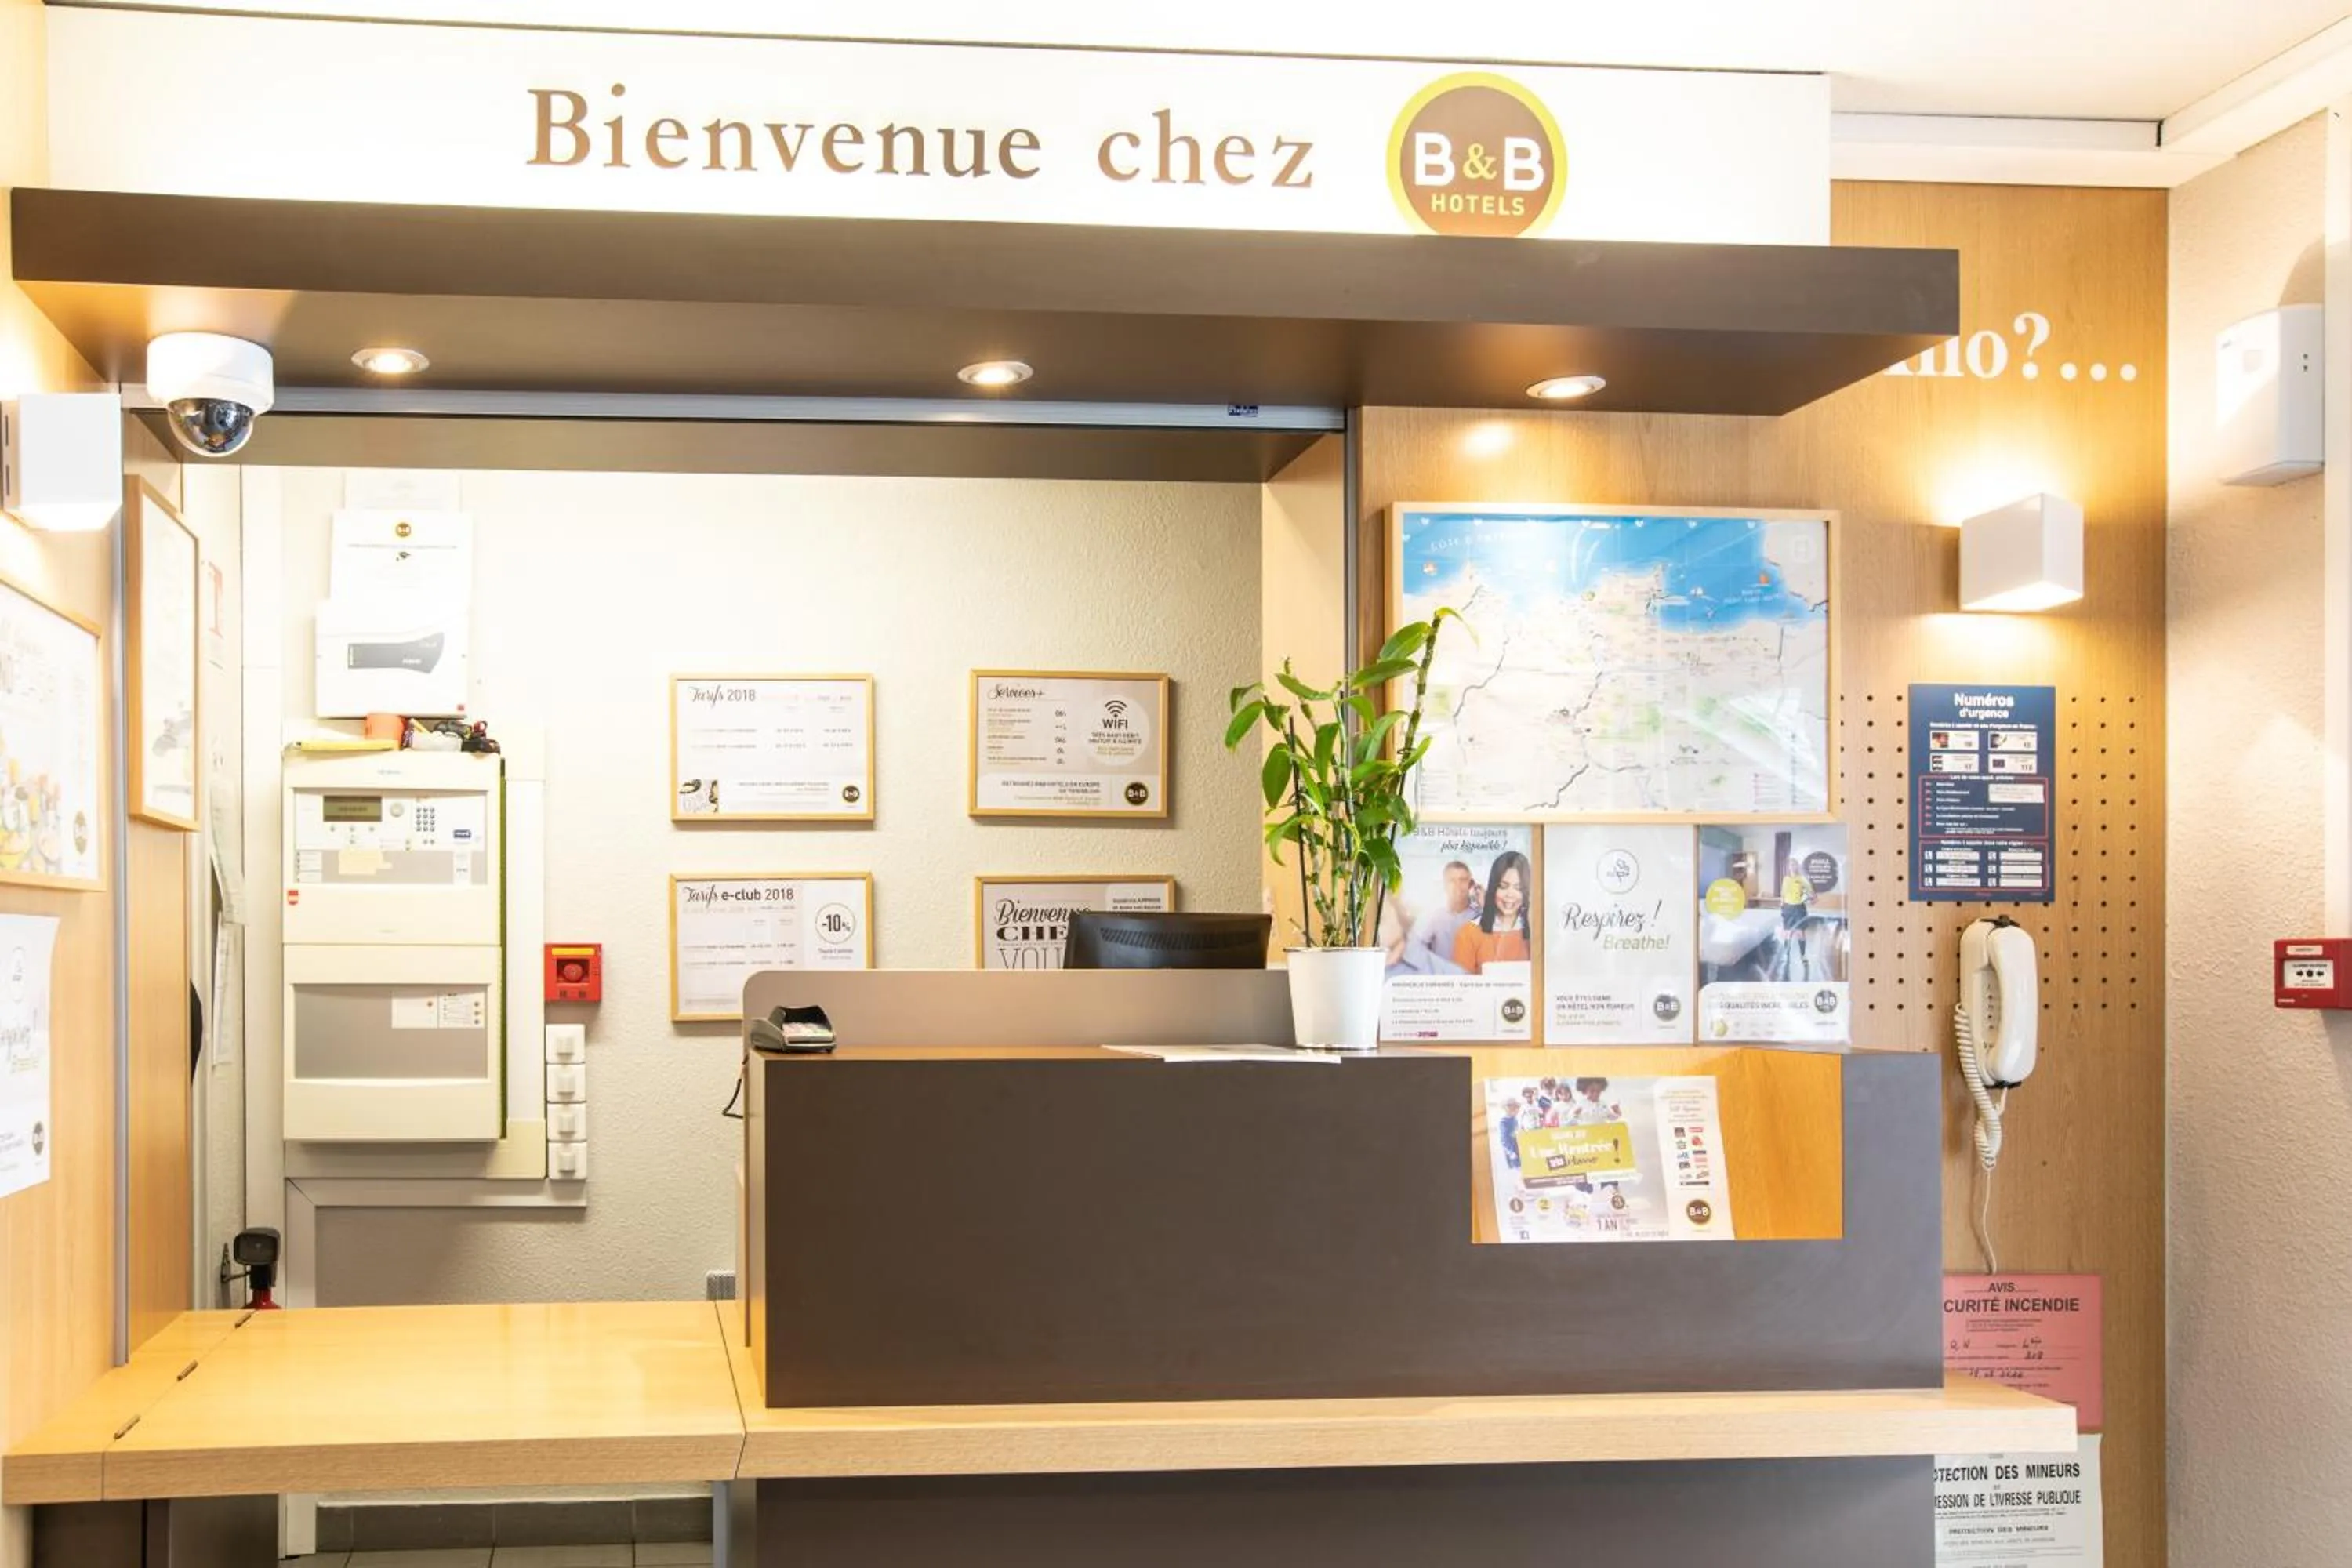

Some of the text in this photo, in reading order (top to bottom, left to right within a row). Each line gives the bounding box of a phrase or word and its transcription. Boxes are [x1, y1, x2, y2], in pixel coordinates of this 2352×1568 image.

[526, 83, 1313, 188] Bienvenue chez
[1414, 132, 1544, 191] B&B
[1431, 194, 1526, 216] HOTELS
[727, 689, 757, 702] 2018
[1954, 693, 2014, 707] Numéros
[1959, 707, 2009, 720] d'urgence
[721, 889, 761, 901] e-club
[765, 888, 794, 901] 2018
[995, 898, 1091, 926] Bienven
[1563, 902, 1645, 941] Respirez
[996, 926, 1067, 942] CHE
[1603, 935, 1671, 949] Breathe!
[998, 947, 1064, 969] VOU
[1988, 1282, 2015, 1293] AVIS
[1944, 1296, 2080, 1312] CURITÉ INCENDIE
[1933, 1463, 2080, 1482] TECTION DES MINEURS
[1934, 1490, 2082, 1508] ESSION DE L'IVRESSE PUBLIQUE
